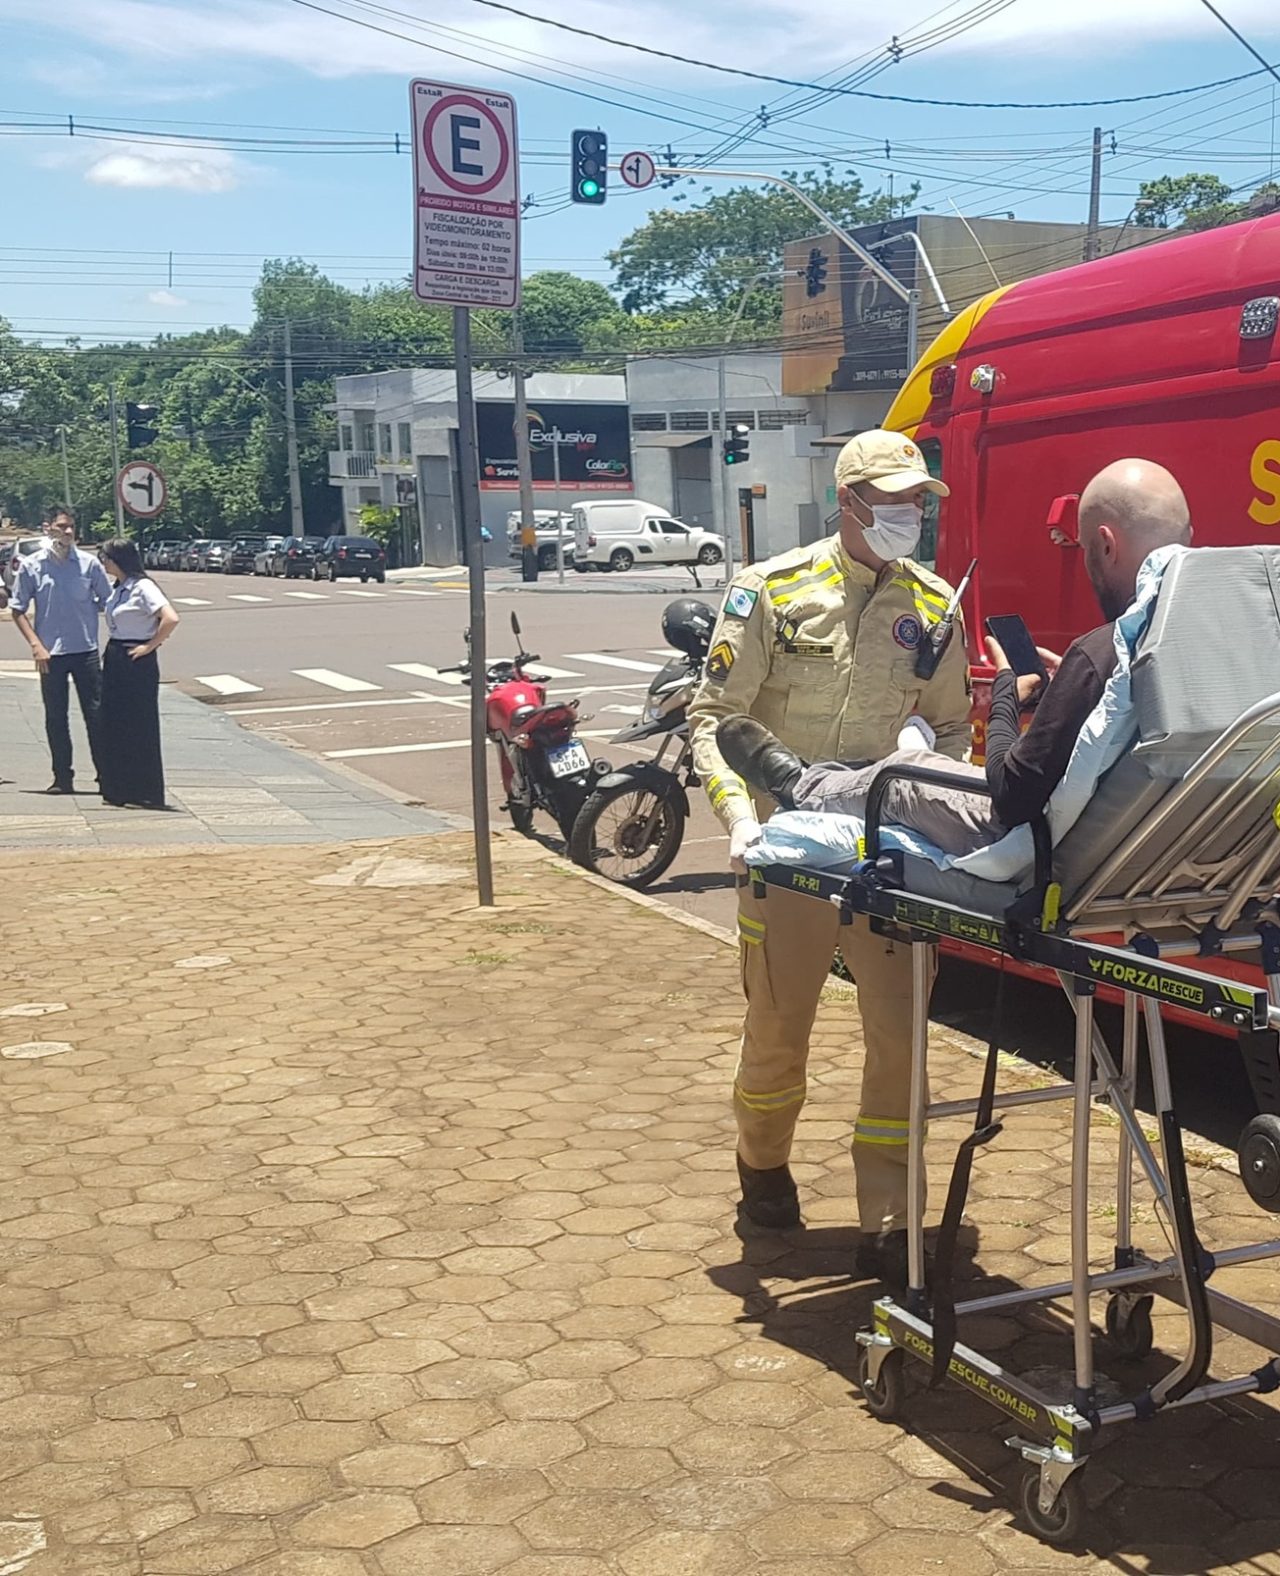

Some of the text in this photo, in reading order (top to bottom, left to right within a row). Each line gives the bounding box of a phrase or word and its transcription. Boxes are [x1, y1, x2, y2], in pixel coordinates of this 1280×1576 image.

[417, 87, 442, 97] EstaR
[485, 98, 509, 108] EstaR
[450, 113, 483, 176] E
[452, 200, 475, 210] MOTOS
[433, 213, 504, 229] FISCALIZAÇÃO POR
[424, 222, 511, 240] VIDEOMONITORAMENTO
[424, 235, 448, 247] Tempo
[450, 240, 479, 250] máximo:
[491, 244, 511, 254] horas
[434, 274, 457, 283] CARGA
[1101, 960, 1202, 1002] FORZA RESCUE
